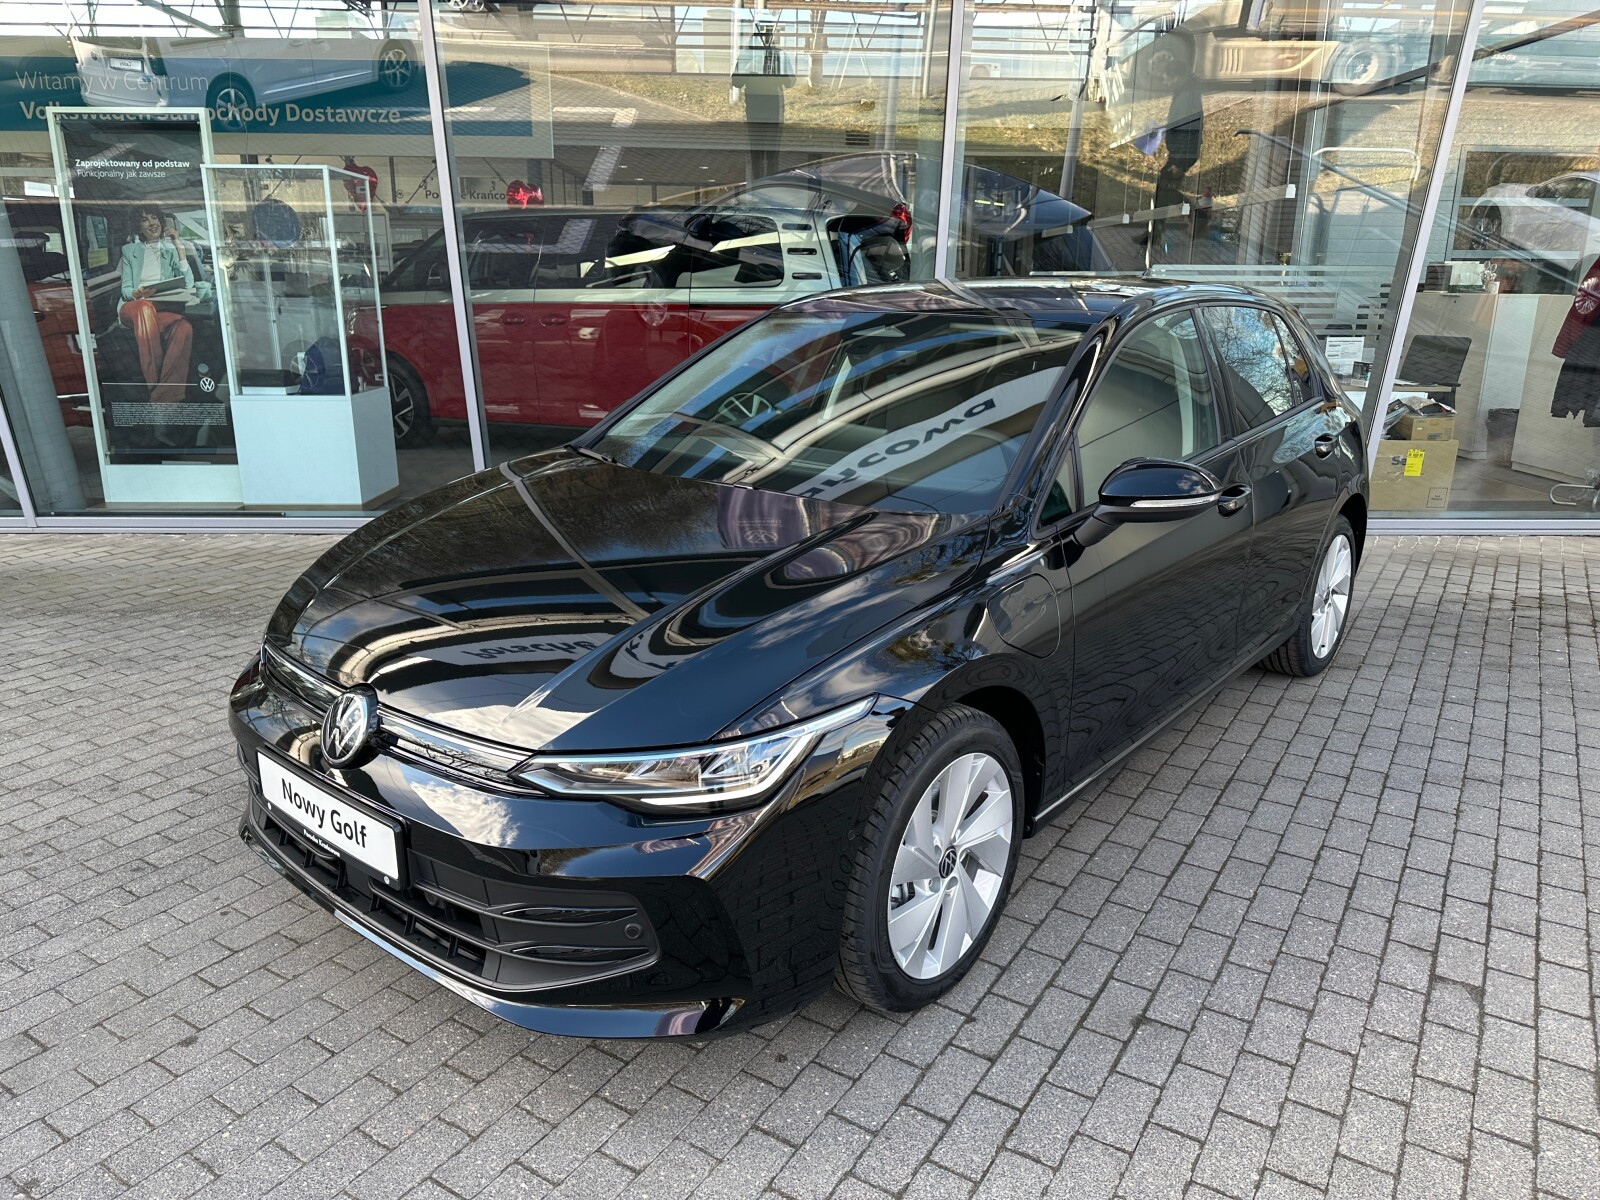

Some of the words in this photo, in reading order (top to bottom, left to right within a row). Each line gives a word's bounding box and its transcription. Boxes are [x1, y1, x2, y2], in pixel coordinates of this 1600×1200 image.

[16, 70, 92, 94] Witamy
[99, 77, 117, 91] w
[123, 72, 209, 91] Centrum
[286, 103, 401, 123] Dostawcze
[75, 159, 141, 169] Zaprojektowany
[142, 159, 153, 168] od
[154, 160, 190, 168] podstaw
[77, 170, 124, 179] Funkcjonalny
[126, 170, 137, 179] jak
[469, 187, 506, 201] Krańco
[1391, 455, 1407, 466] Se
[281, 778, 325, 829] Nowy
[330, 809, 367, 849] Golf
